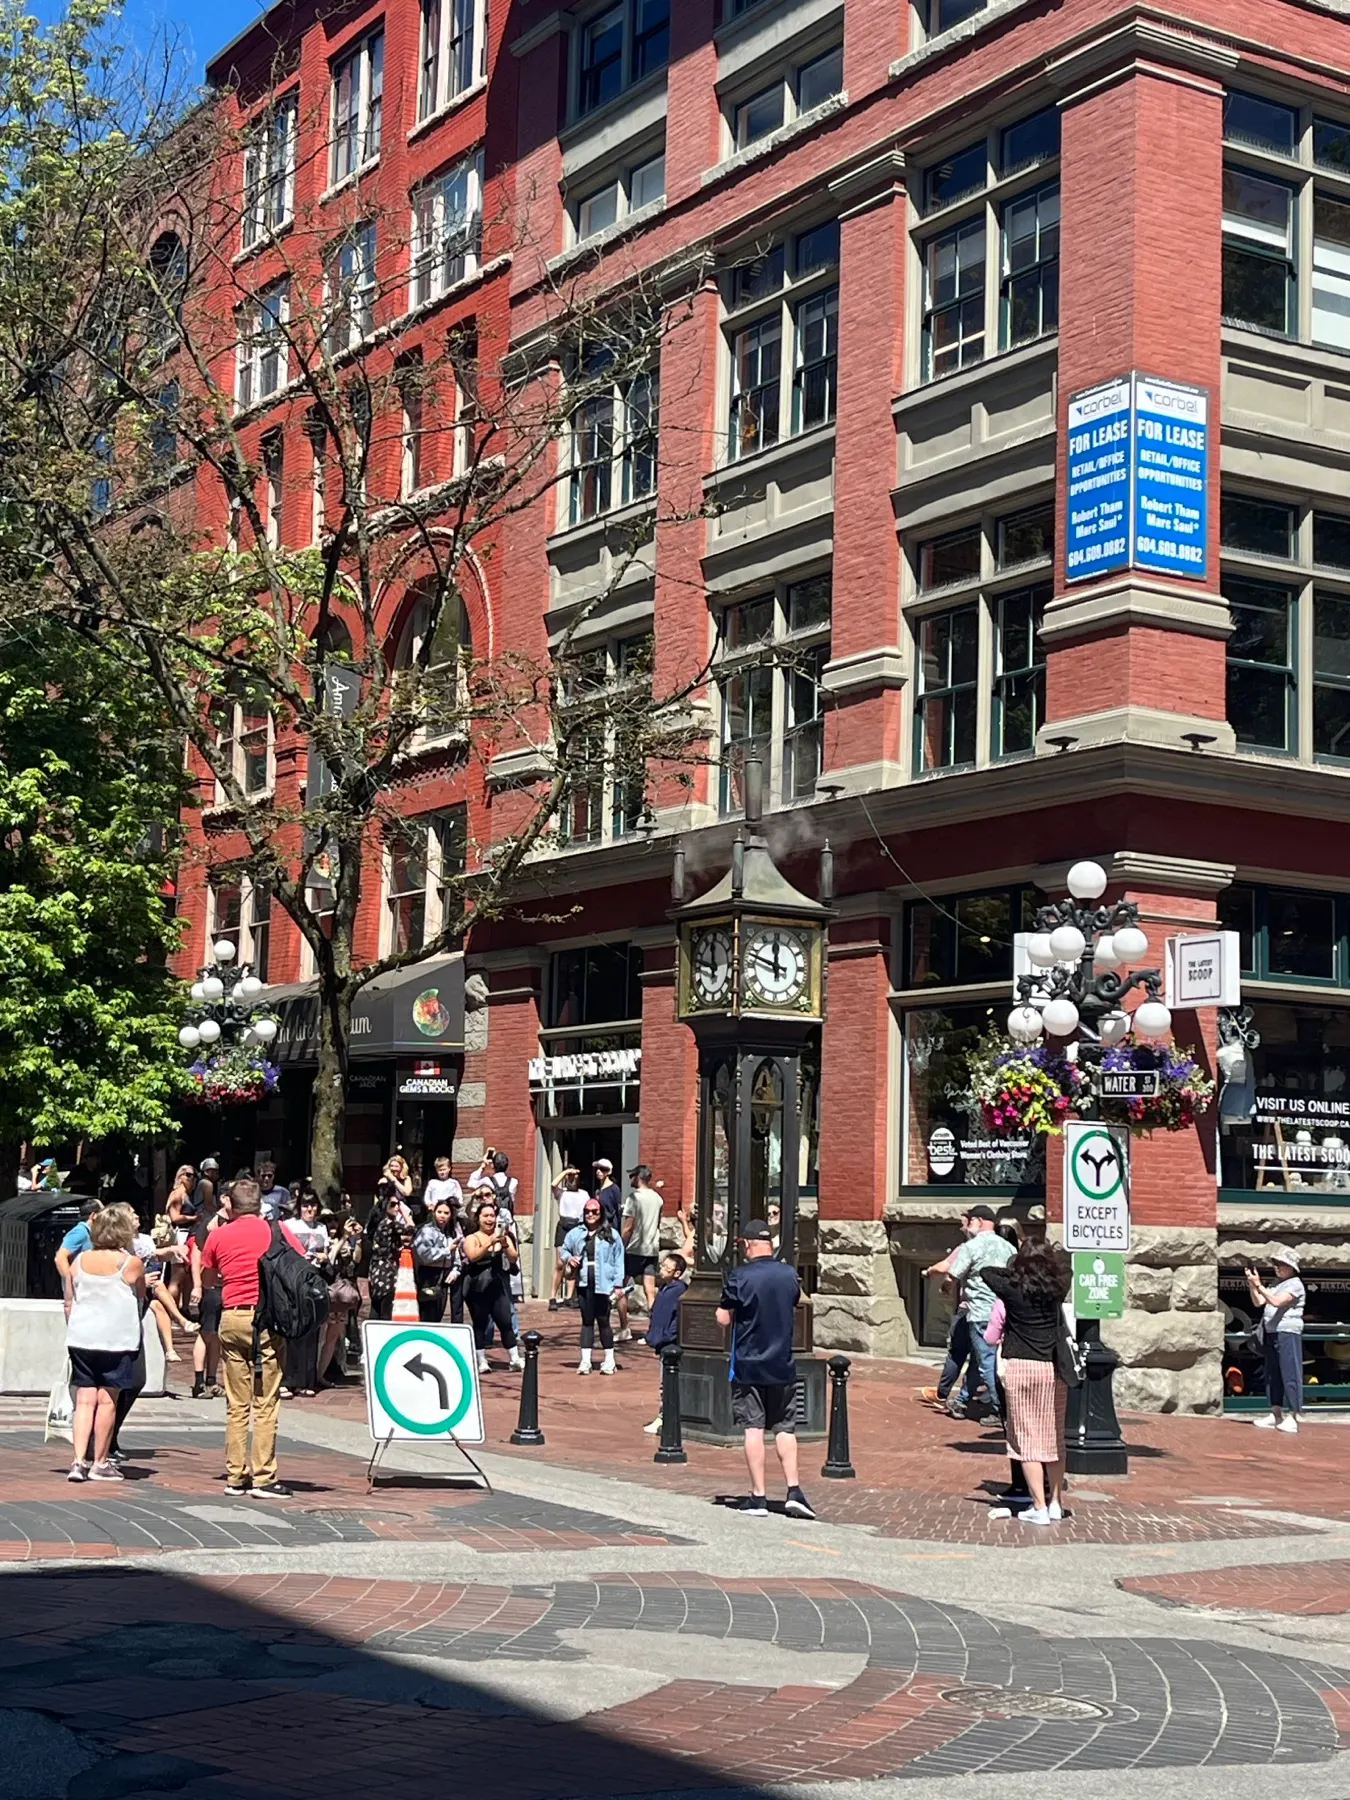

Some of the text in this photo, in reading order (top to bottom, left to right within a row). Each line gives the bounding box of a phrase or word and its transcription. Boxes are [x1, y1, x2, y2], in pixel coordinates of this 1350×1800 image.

[1083, 390, 1122, 415] corbel
[1154, 393, 1199, 413] corbel
[1069, 420, 1128, 456] FOR LEASE
[1137, 418, 1205, 450] FOR LEASE
[1071, 450, 1125, 478] RETAIL/OFFICE
[1140, 449, 1201, 473] RETAIL/OFFICE
[1070, 468, 1126, 496] OPPORTUNITIES
[1138, 466, 1202, 491] OPPORTUNITIES
[1071, 500, 1123, 525] Robert Tham
[1140, 495, 1200, 520] Robert Tham
[1146, 513, 1171, 530] Marc
[1076, 523, 1097, 539] Marc
[1188, 968, 1213, 981] SCOOP
[400, 1084, 455, 1094] GEMS & ROCKS
[405, 1078, 448, 1087] CANADIAN
[1104, 1076, 1136, 1092] WATER
[1256, 1096, 1350, 1115] VISIT US ONLINE
[978, 1140, 991, 1148] Best
[1251, 1143, 1274, 1160] THE
[1277, 1144, 1317, 1162] LATEST
[986, 1150, 1011, 1160] Clothing
[1011, 1151, 1028, 1159] Store
[1078, 1206, 1118, 1220] EXCEPT
[1072, 1225, 1123, 1239] BICYCLES
[1079, 1274, 1119, 1287] CAR FREE
[1088, 1287, 1110, 1300] ZONE
